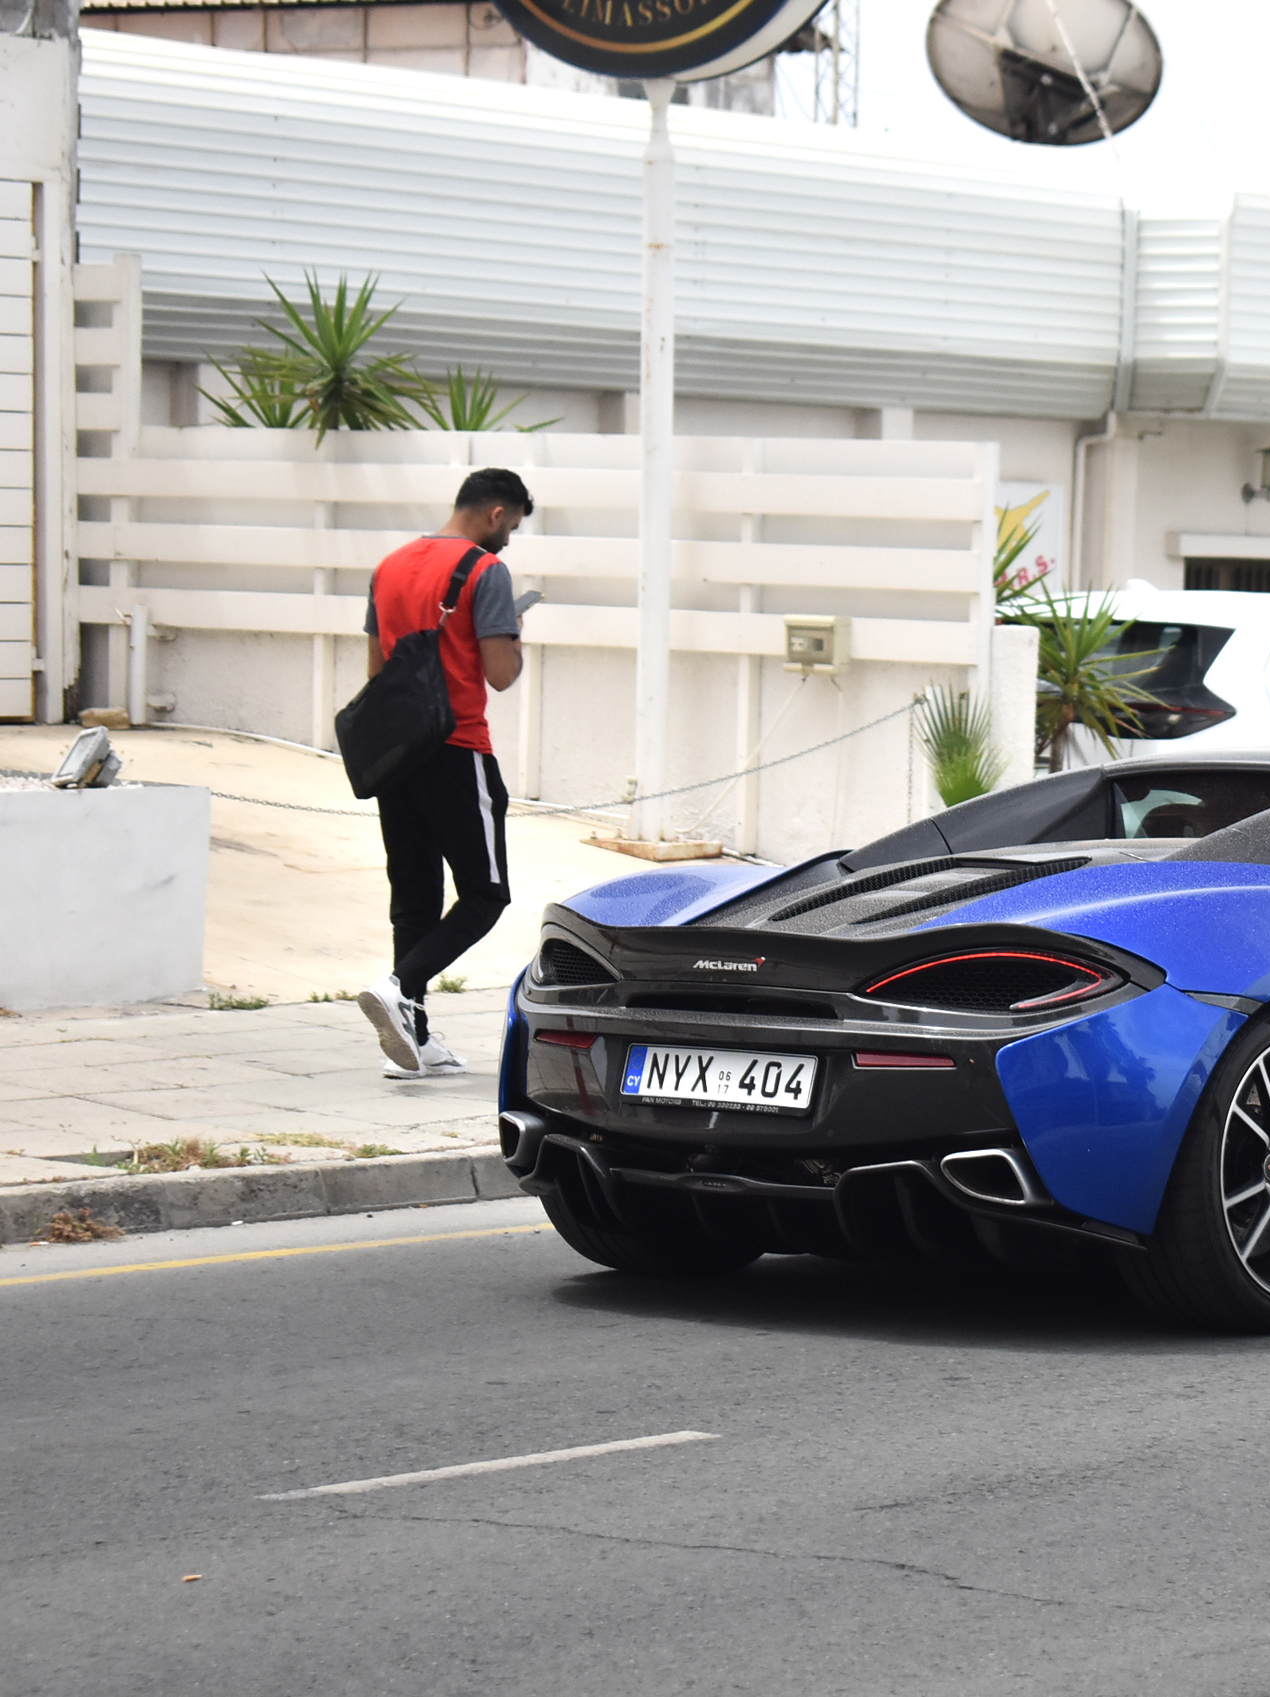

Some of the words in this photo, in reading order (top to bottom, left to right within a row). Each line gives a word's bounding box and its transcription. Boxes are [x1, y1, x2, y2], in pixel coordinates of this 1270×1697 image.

[692, 959, 757, 972] McLaren
[627, 1075, 641, 1087] CY
[646, 1052, 714, 1093] NYX
[738, 1059, 804, 1100] 404
[718, 1071, 731, 1081] 06
[717, 1084, 729, 1094] 17
[655, 1097, 682, 1106] MOTORS
